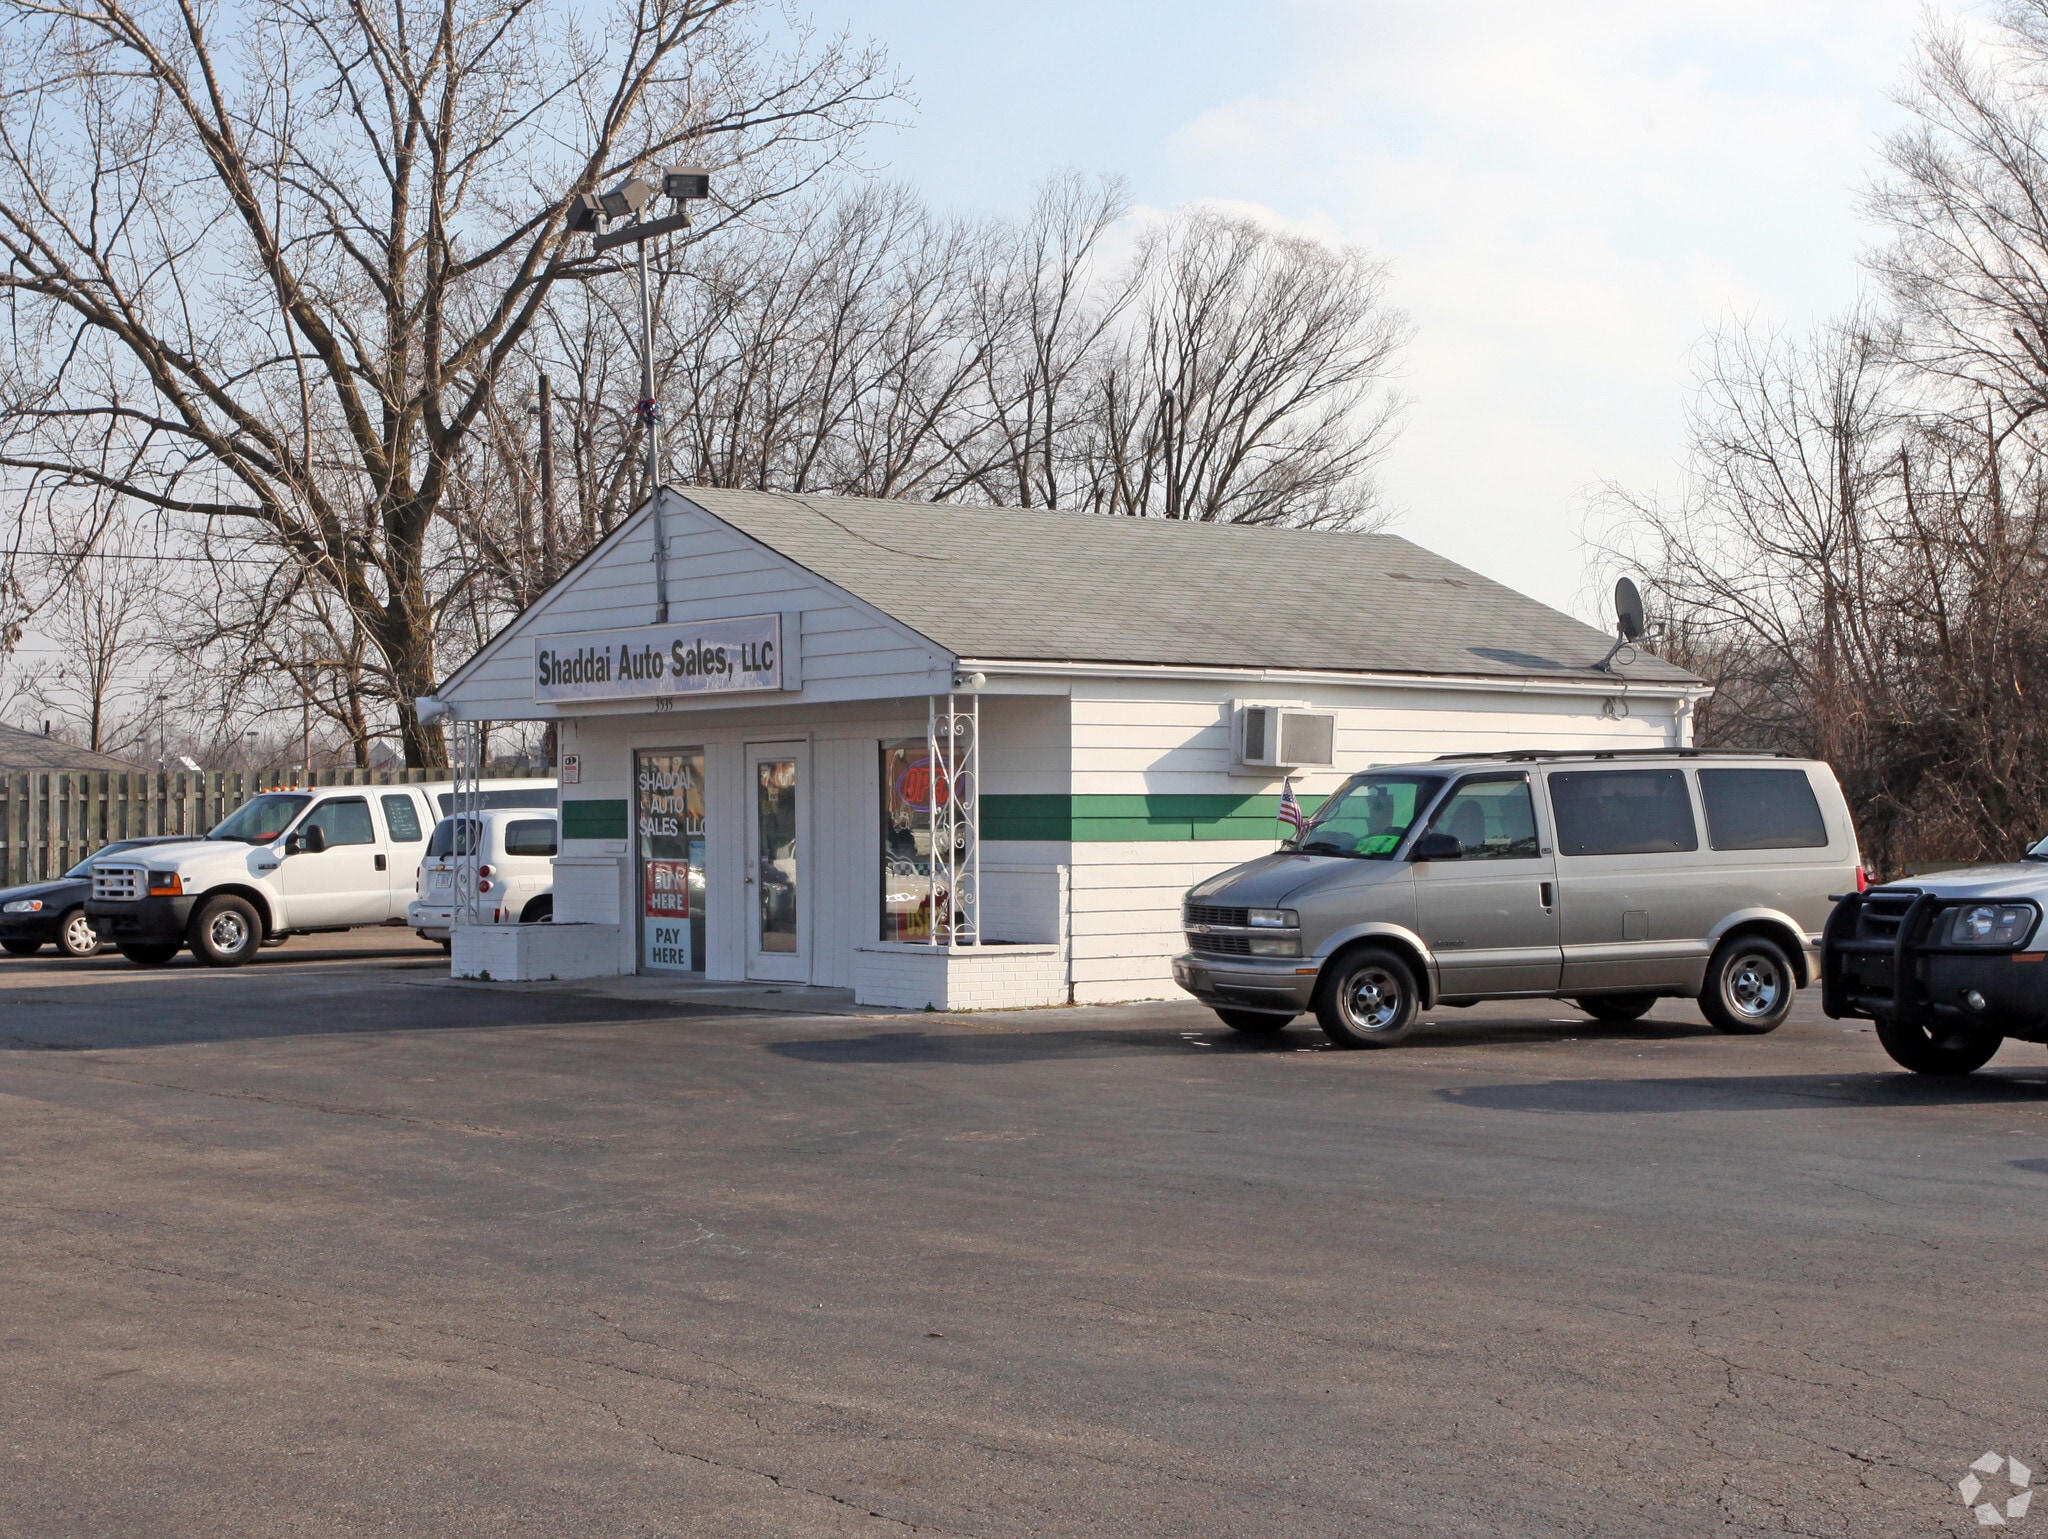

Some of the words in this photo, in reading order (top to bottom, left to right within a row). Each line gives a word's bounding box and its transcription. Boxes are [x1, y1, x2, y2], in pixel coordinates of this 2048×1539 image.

[539, 646, 611, 686] Shaddai
[618, 644, 664, 681] Auto
[671, 638, 733, 682] Sales,
[742, 641, 774, 672] LLC
[656, 698, 673, 712] 3535
[651, 795, 684, 814] AUTO
[640, 817, 678, 836] SALES
[655, 872, 680, 890] BUY
[652, 893, 684, 910] HERE
[656, 928, 680, 944] PAY
[653, 947, 684, 964] HERE
